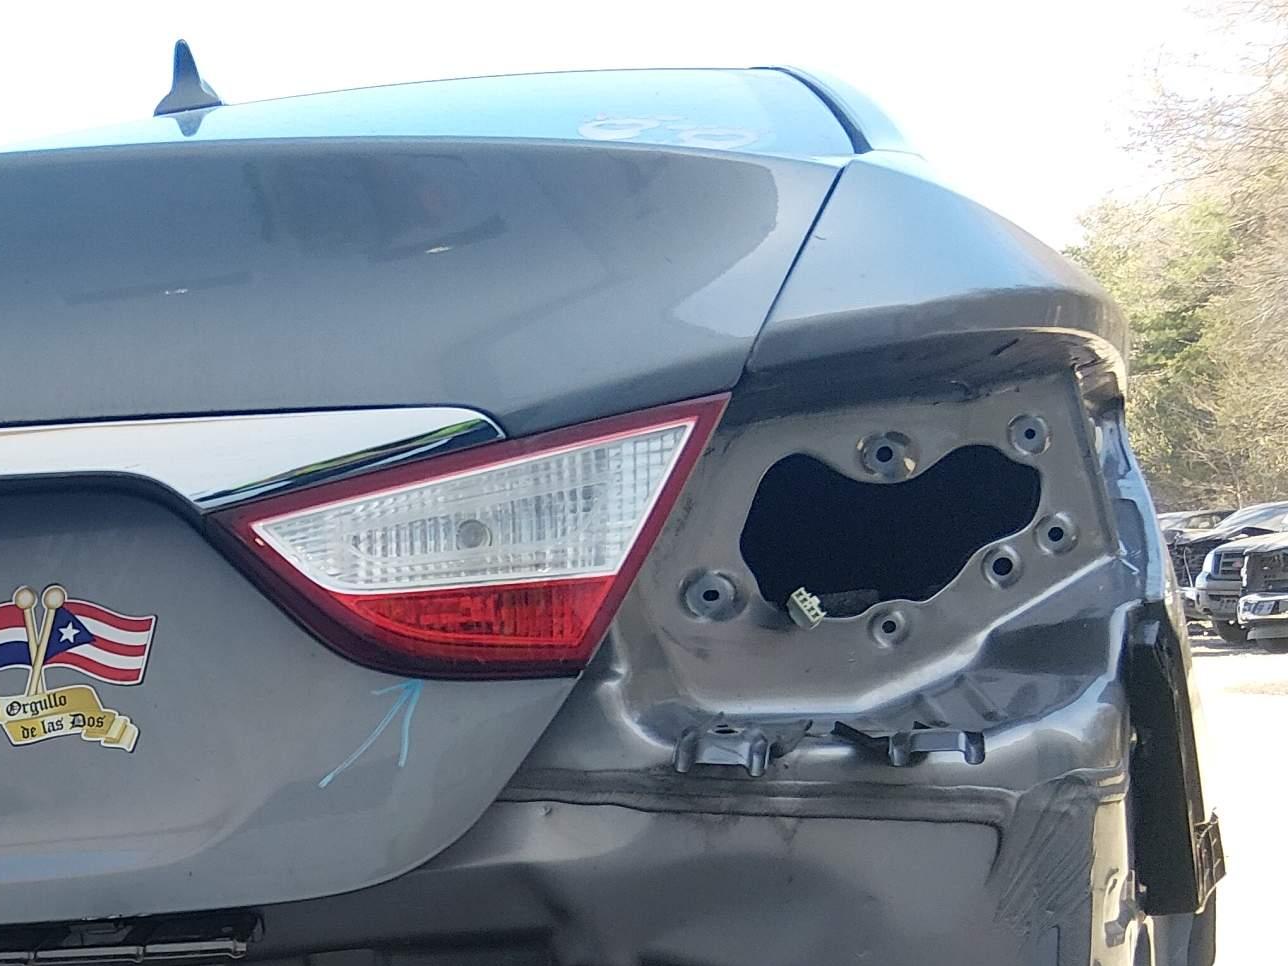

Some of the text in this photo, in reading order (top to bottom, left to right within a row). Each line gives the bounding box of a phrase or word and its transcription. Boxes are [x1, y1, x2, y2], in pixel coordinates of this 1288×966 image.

[6, 693, 67, 717] Orgullo
[21, 713, 105, 739] de las Dos
